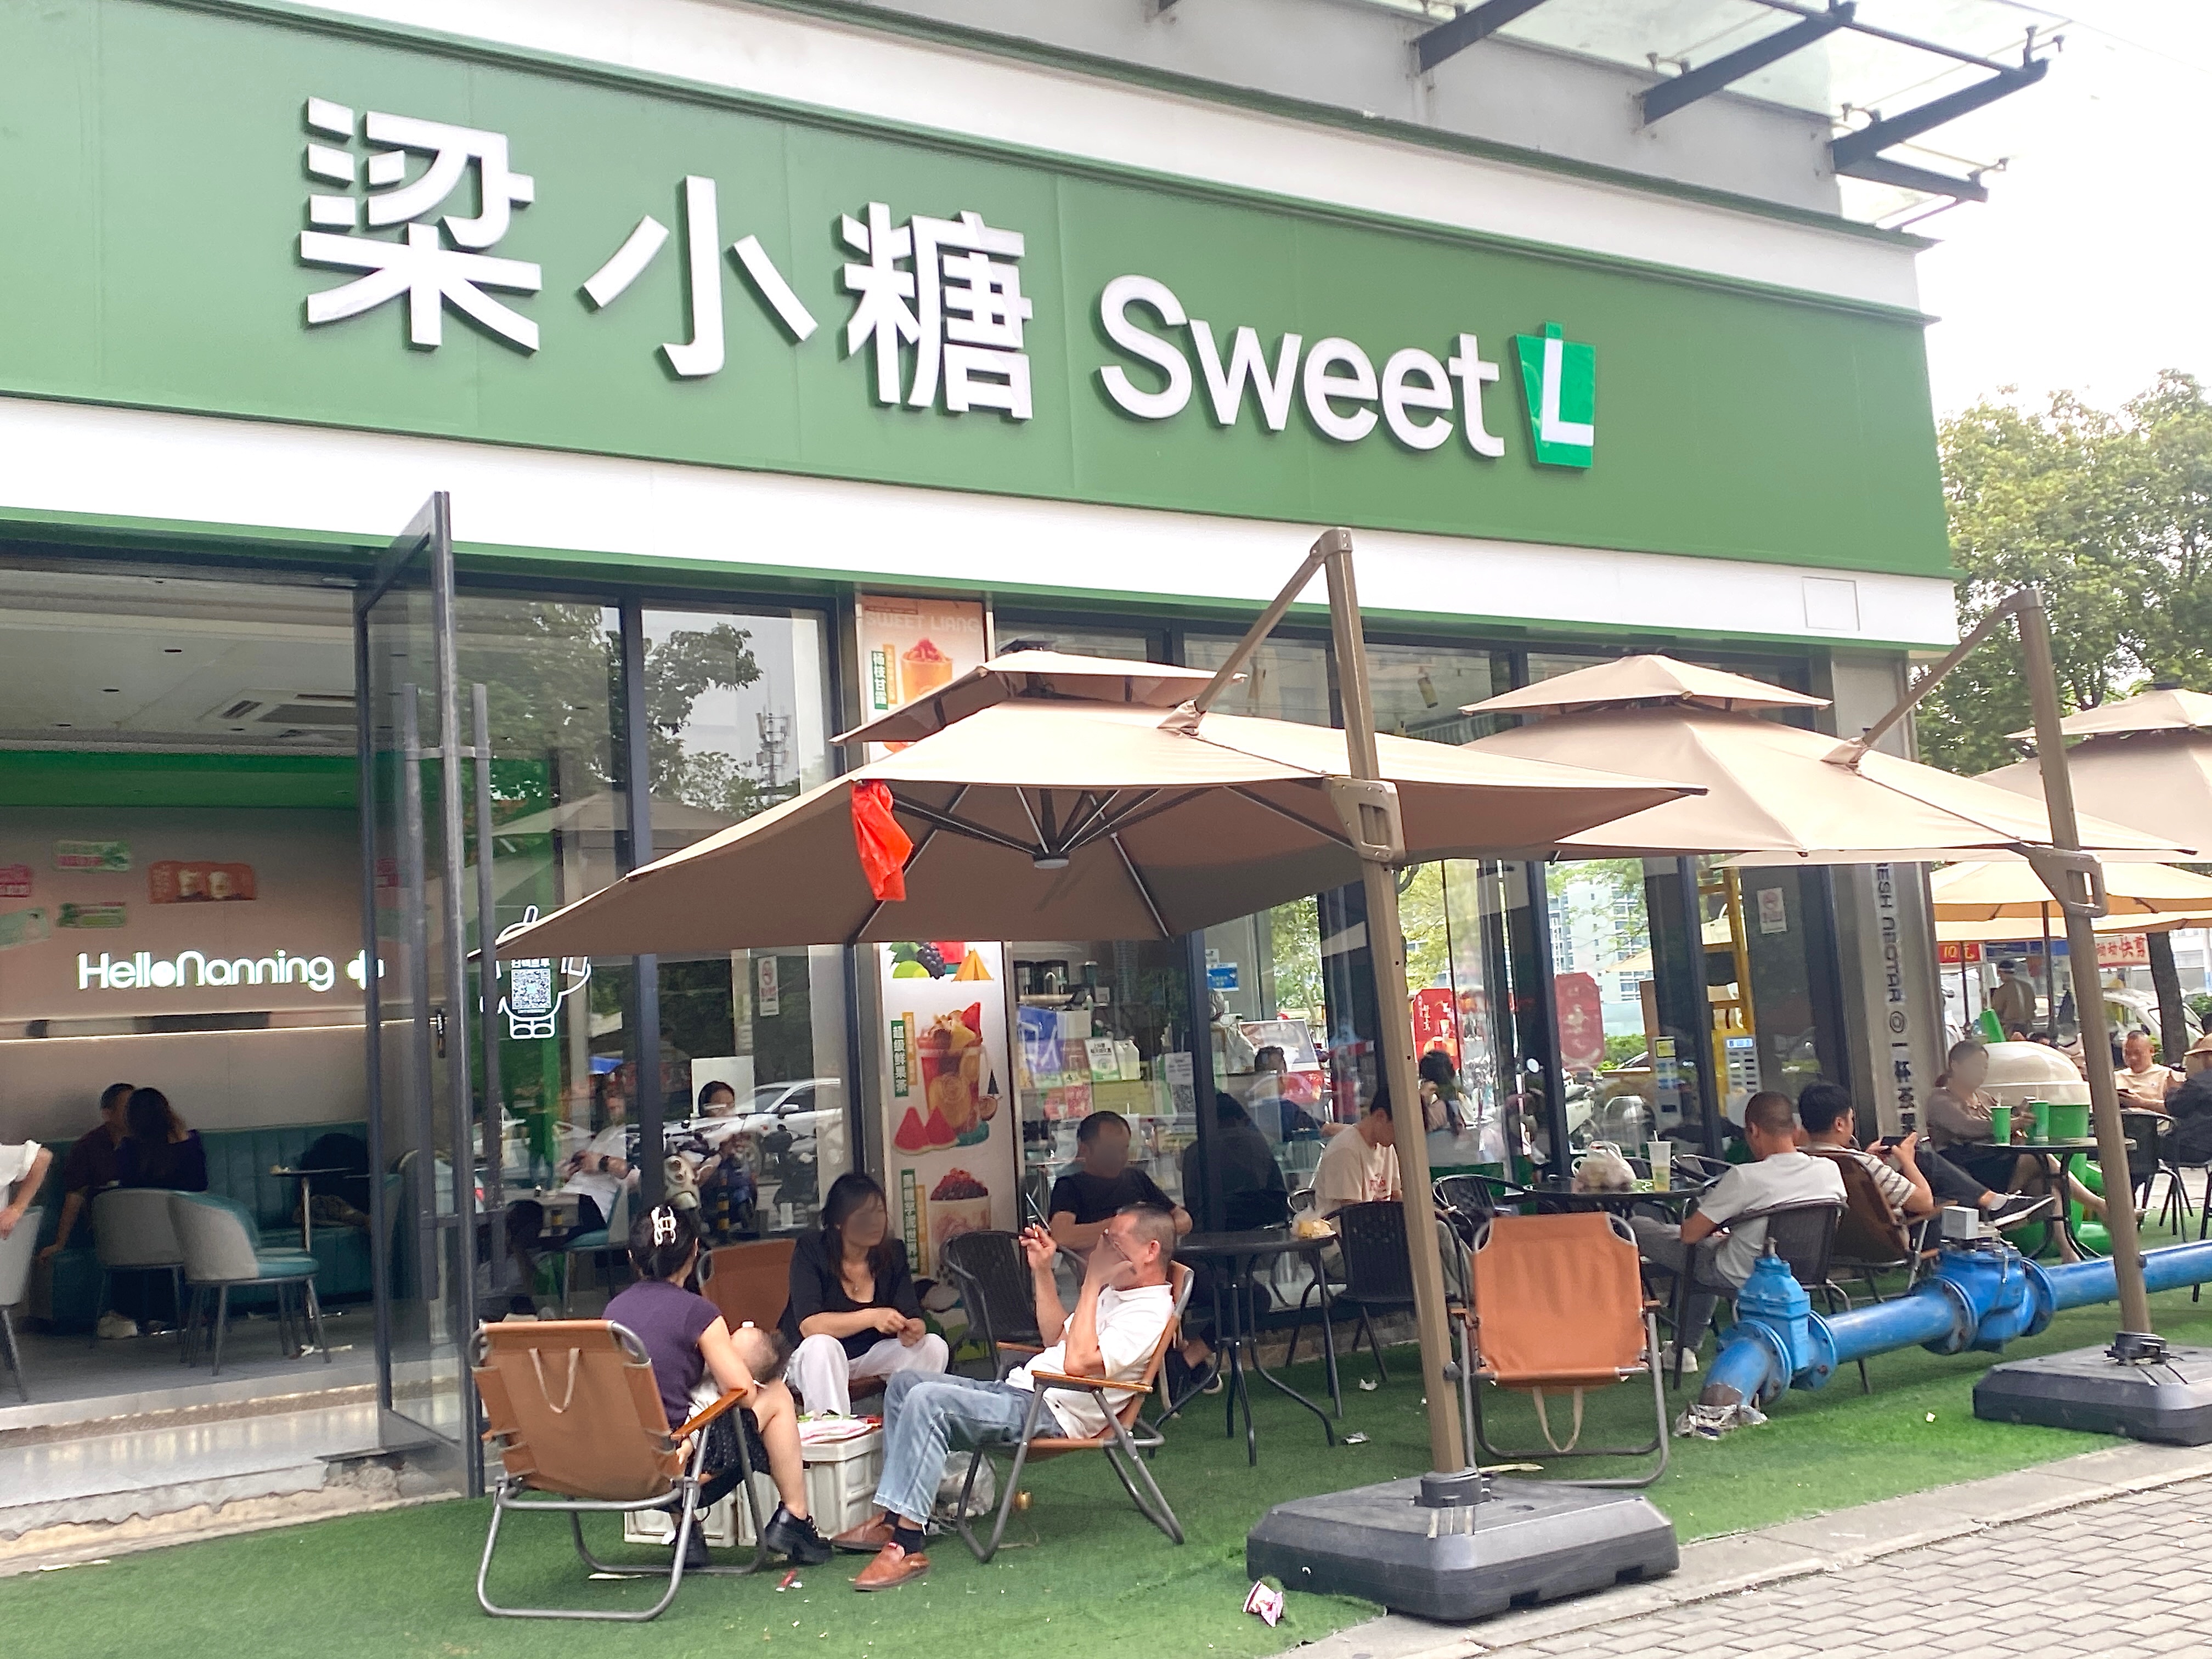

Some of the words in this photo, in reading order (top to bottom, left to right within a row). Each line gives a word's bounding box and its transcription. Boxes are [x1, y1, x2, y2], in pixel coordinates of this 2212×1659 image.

[300, 95, 1034, 420] 梁小糖
[1099, 274, 1505, 458] Sweet
[1875, 863, 1893, 909] ESH
